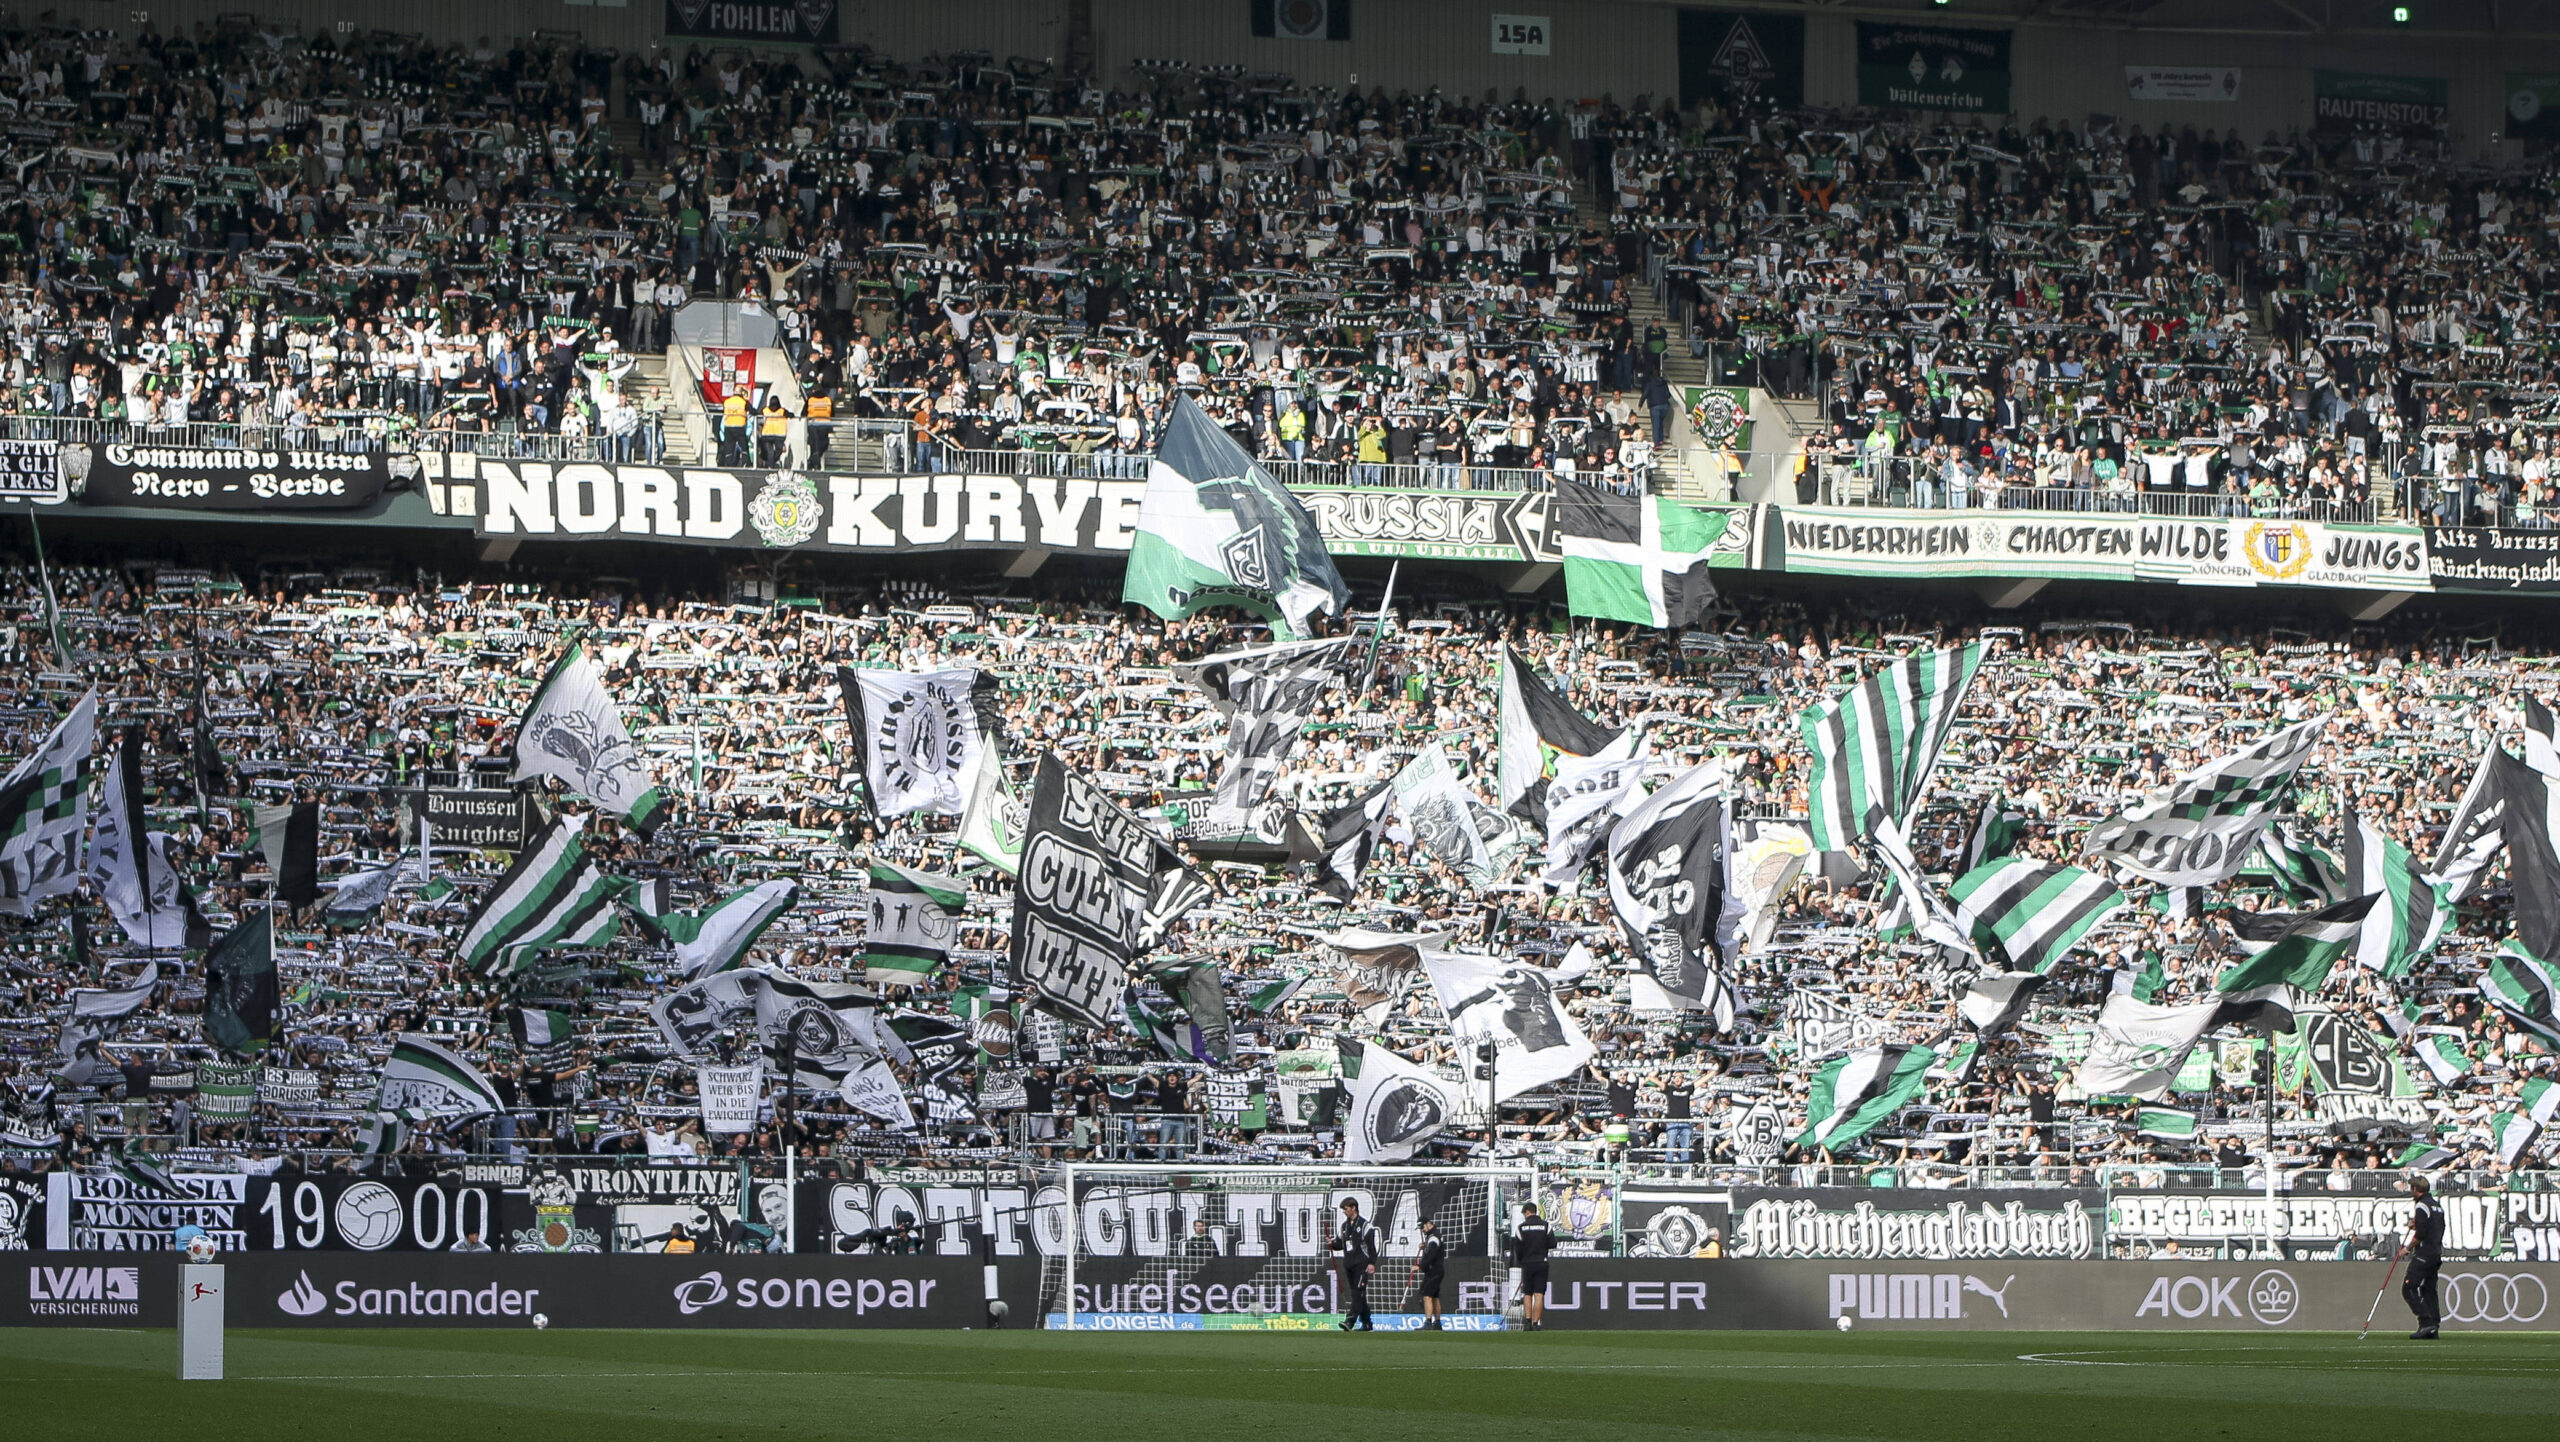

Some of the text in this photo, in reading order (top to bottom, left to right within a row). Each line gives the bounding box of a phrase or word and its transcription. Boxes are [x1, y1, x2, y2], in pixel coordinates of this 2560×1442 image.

[711, 3, 796, 33] FOHLEN
[1498, 24, 1543, 45] 15A
[2319, 97, 2443, 125] RAUTENSTOLZ
[19, 456, 55, 473] GLI
[105, 444, 372, 472] Commando Ultra
[131, 472, 210, 497] Nero
[249, 473, 346, 499] Verde
[480, 461, 1147, 550] NORD KURVE
[1301, 494, 1499, 545] RUSSIA
[1787, 518, 1970, 554] NIEDERRHEIN
[2006, 523, 2131, 557] CHAOTEN
[2139, 525, 2422, 573] WILDE JUNGS
[2434, 528, 2479, 548] Alte
[2193, 564, 2252, 578] MÖNCHEN
[2308, 571, 2368, 585] GLADBACH
[428, 794, 517, 816] Borussen
[428, 822, 520, 844] Knights
[264, 1067, 319, 1086] 125 JAHRE
[708, 1071, 754, 1082] SCHWARZ
[264, 1085, 319, 1100] BORUSSIA
[737, 1085, 754, 1095] BIS
[1207, 1083, 1249, 1096] DER
[716, 1098, 748, 1108] IN DIE
[708, 1110, 753, 1121] EWIGKEIT
[465, 1166, 523, 1181] BANDA
[572, 1168, 738, 1195] FRONTLINE
[872, 1169, 1017, 1184] ASCENDENTE
[82, 1199, 236, 1228] MÖNCHEN
[260, 1182, 324, 1248] 19
[1731, 1199, 2092, 1258] Mönchengladbach
[30, 1267, 103, 1300] LVM
[1074, 1270, 1337, 1314] sure[secure]
[1458, 1281, 1707, 1310] RUTER
[335, 1280, 539, 1316] Santander
[736, 1278, 936, 1315] sonepar
[1829, 1274, 1960, 1318] PUMA
[2135, 1277, 2242, 1318] AOK
[30, 1303, 138, 1315] VERSICHERUNG
[1089, 1315, 1175, 1331] JONGEN
[1396, 1315, 1480, 1331] JOGEN
